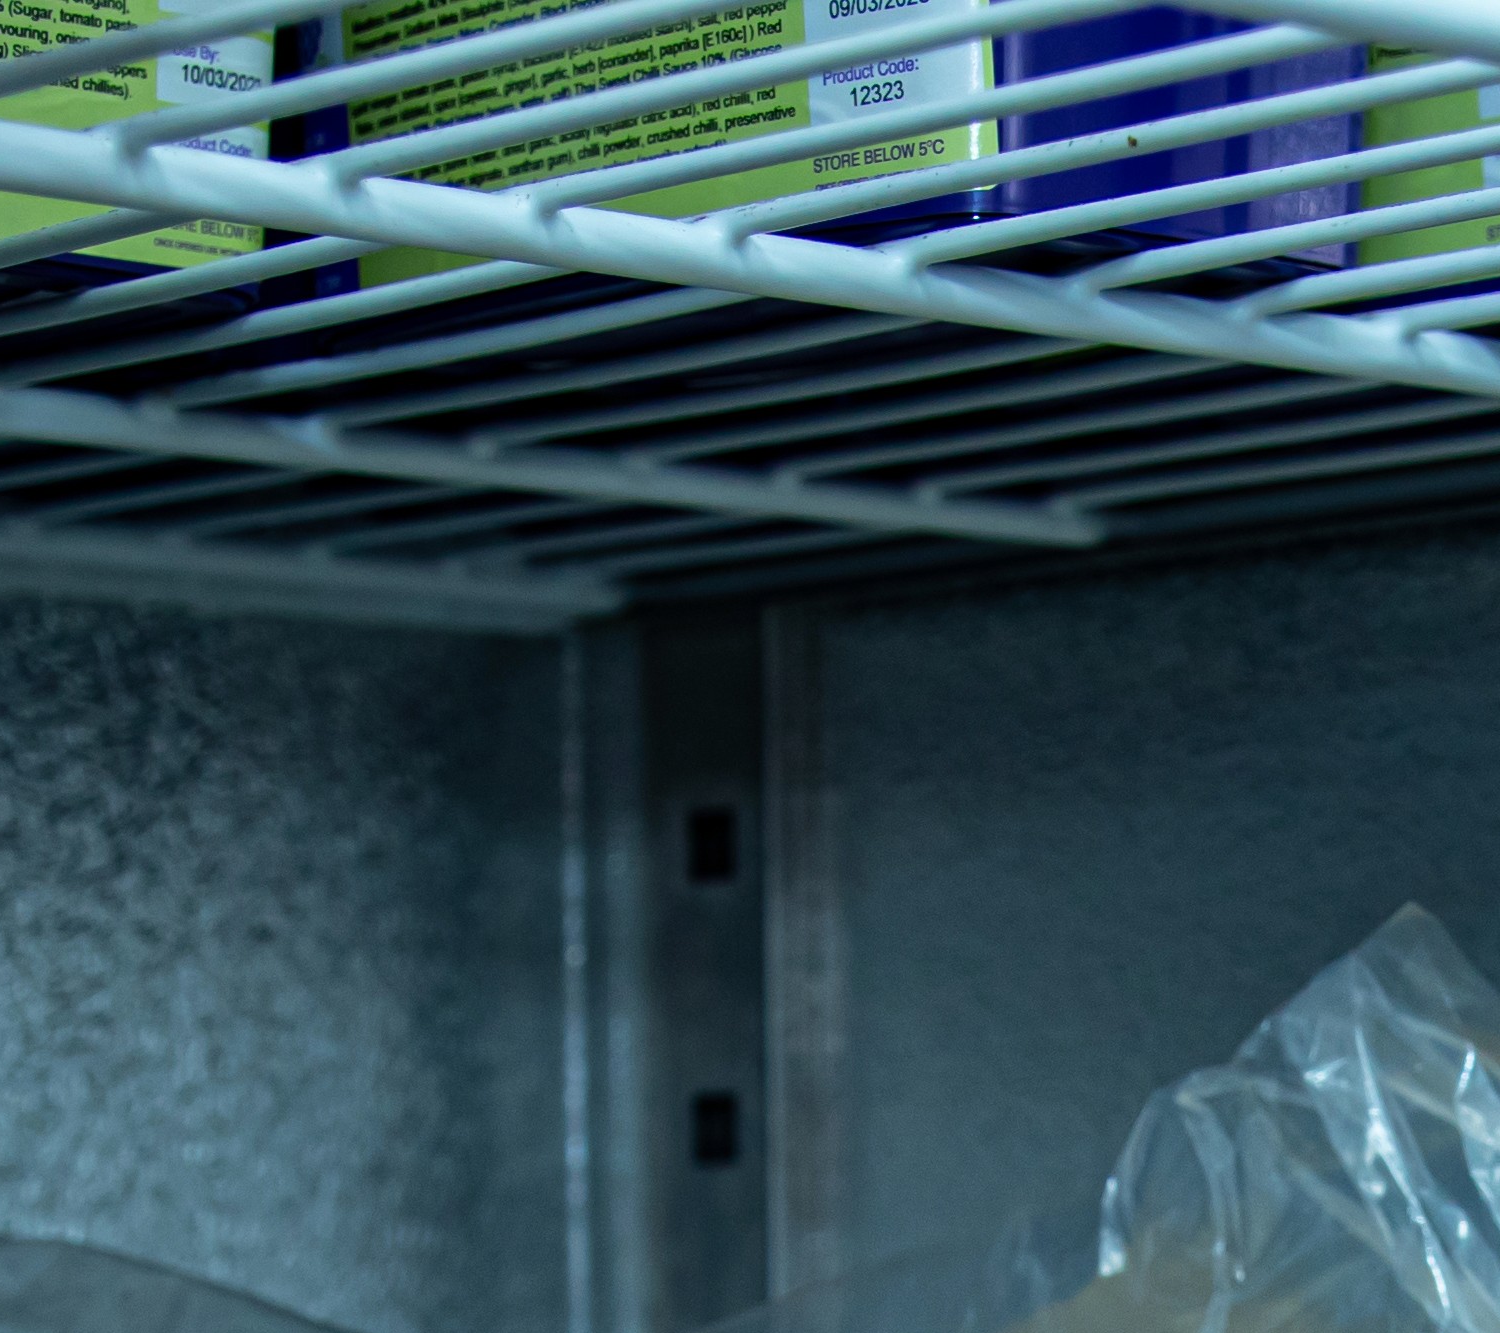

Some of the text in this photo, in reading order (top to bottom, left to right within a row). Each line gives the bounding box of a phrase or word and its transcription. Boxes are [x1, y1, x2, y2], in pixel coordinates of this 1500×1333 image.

[8, 1, 56, 23] (Sugar,
[59, 9, 102, 28] tomato
[724, 8, 743, 22] red
[746, 0, 788, 21] pepper
[758, 19, 783, 37] Red
[822, 57, 919, 87] Product Code:
[757, 85, 776, 102] red
[850, 80, 905, 107] 12323
[725, 104, 796, 132] preservative
[813, 138, 945, 174] STORE BELOW 5°C
